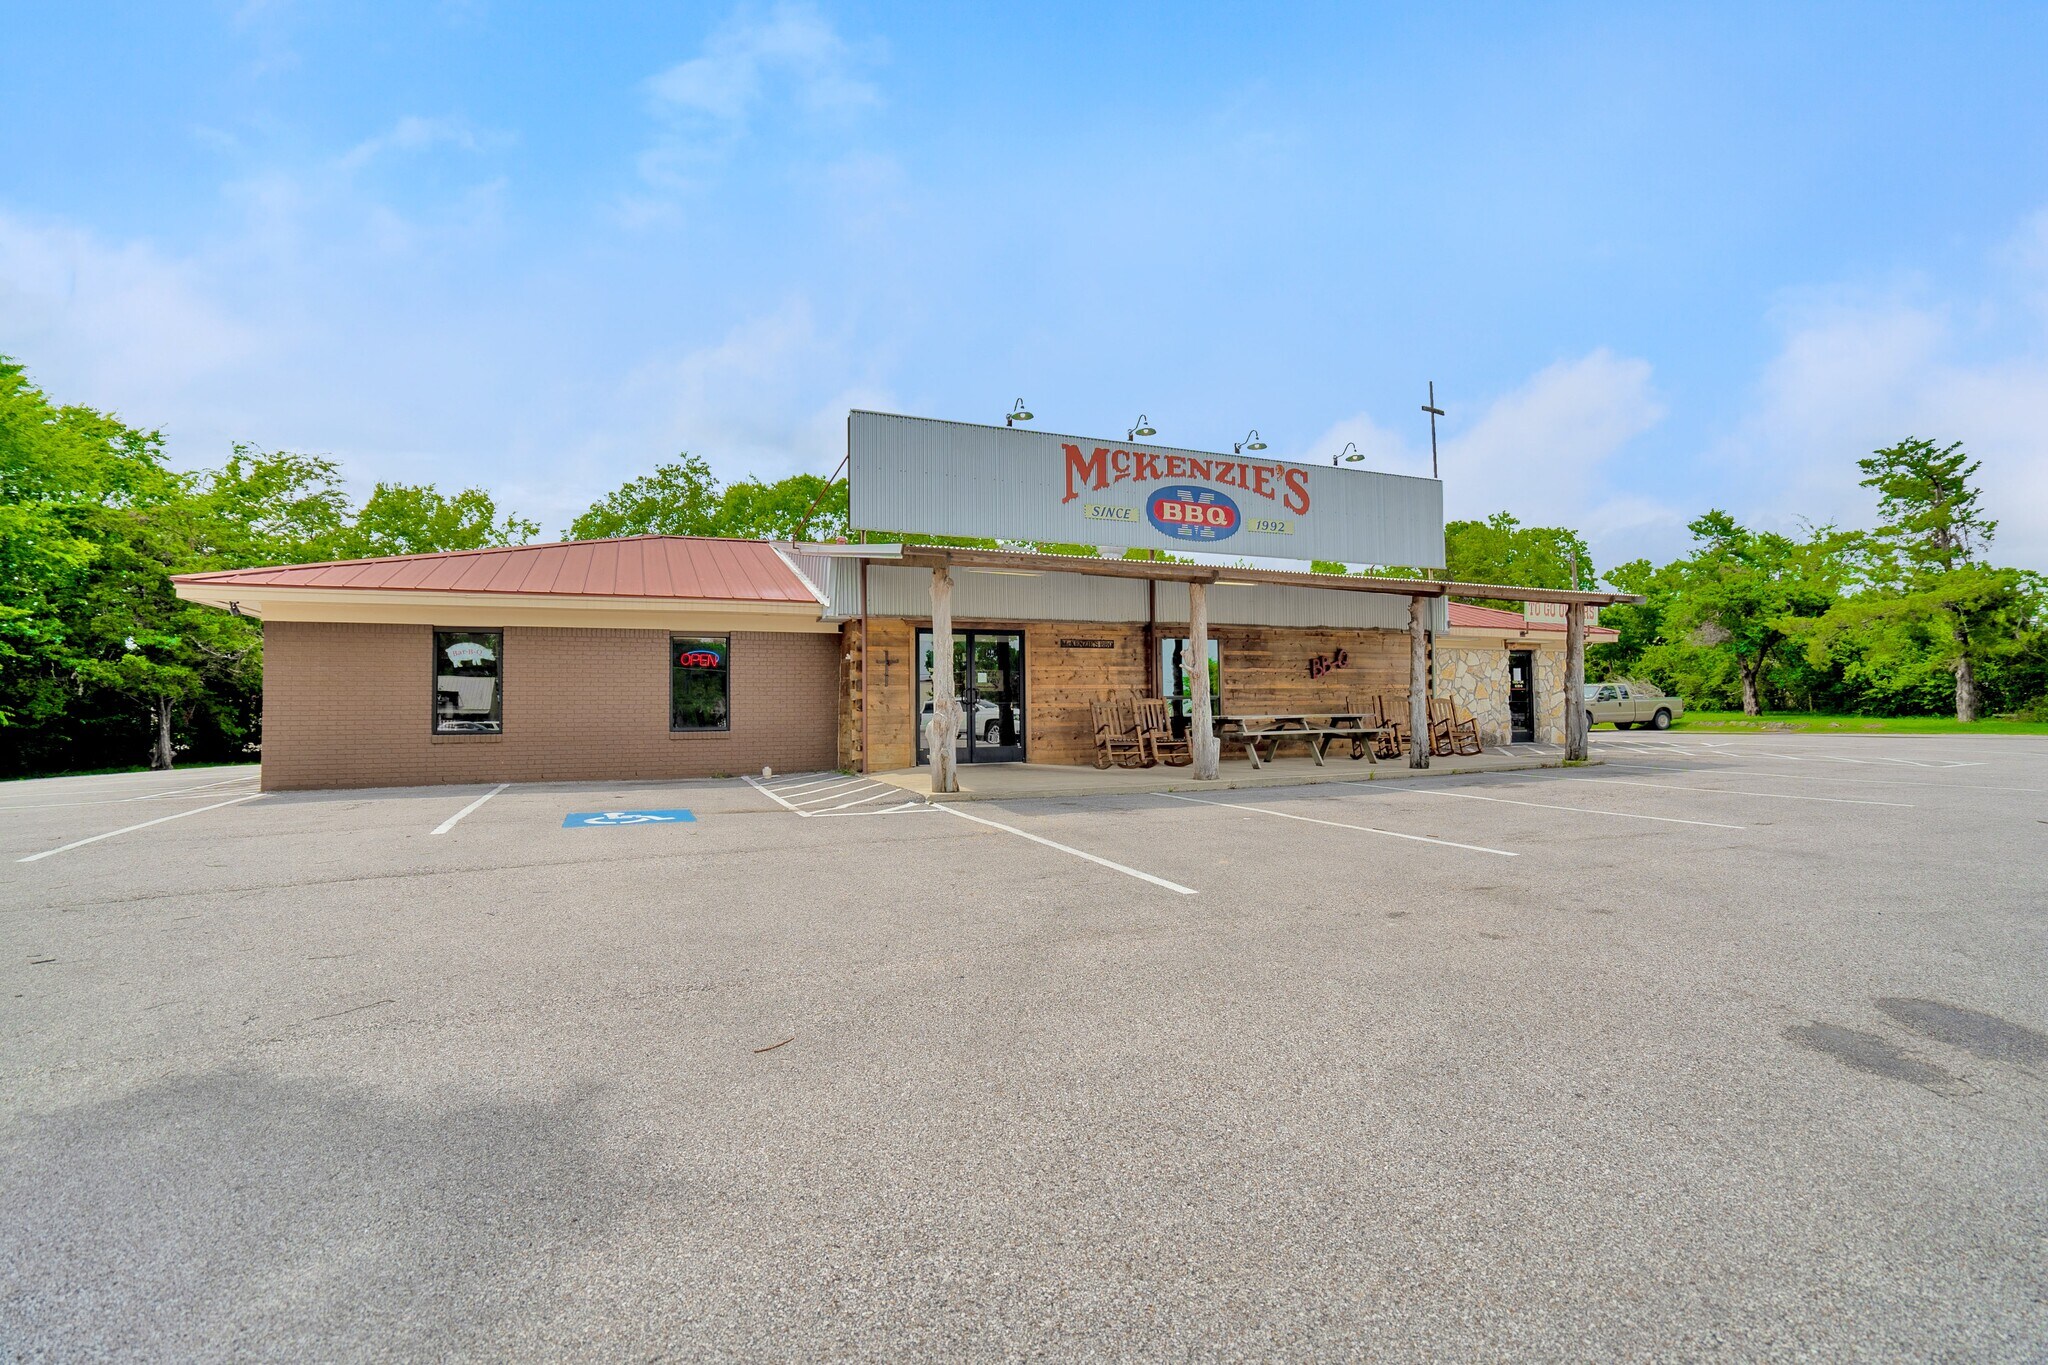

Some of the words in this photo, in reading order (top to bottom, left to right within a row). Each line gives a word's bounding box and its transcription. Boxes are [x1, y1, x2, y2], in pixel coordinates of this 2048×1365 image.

[1091, 506, 1131, 519] SINCE
[1162, 502, 1228, 525] BBQ
[1256, 520, 1285, 532] 1992
[1529, 602, 1540, 616] TO
[1544, 603, 1555, 617] GO
[681, 653, 717, 667] OPEN
